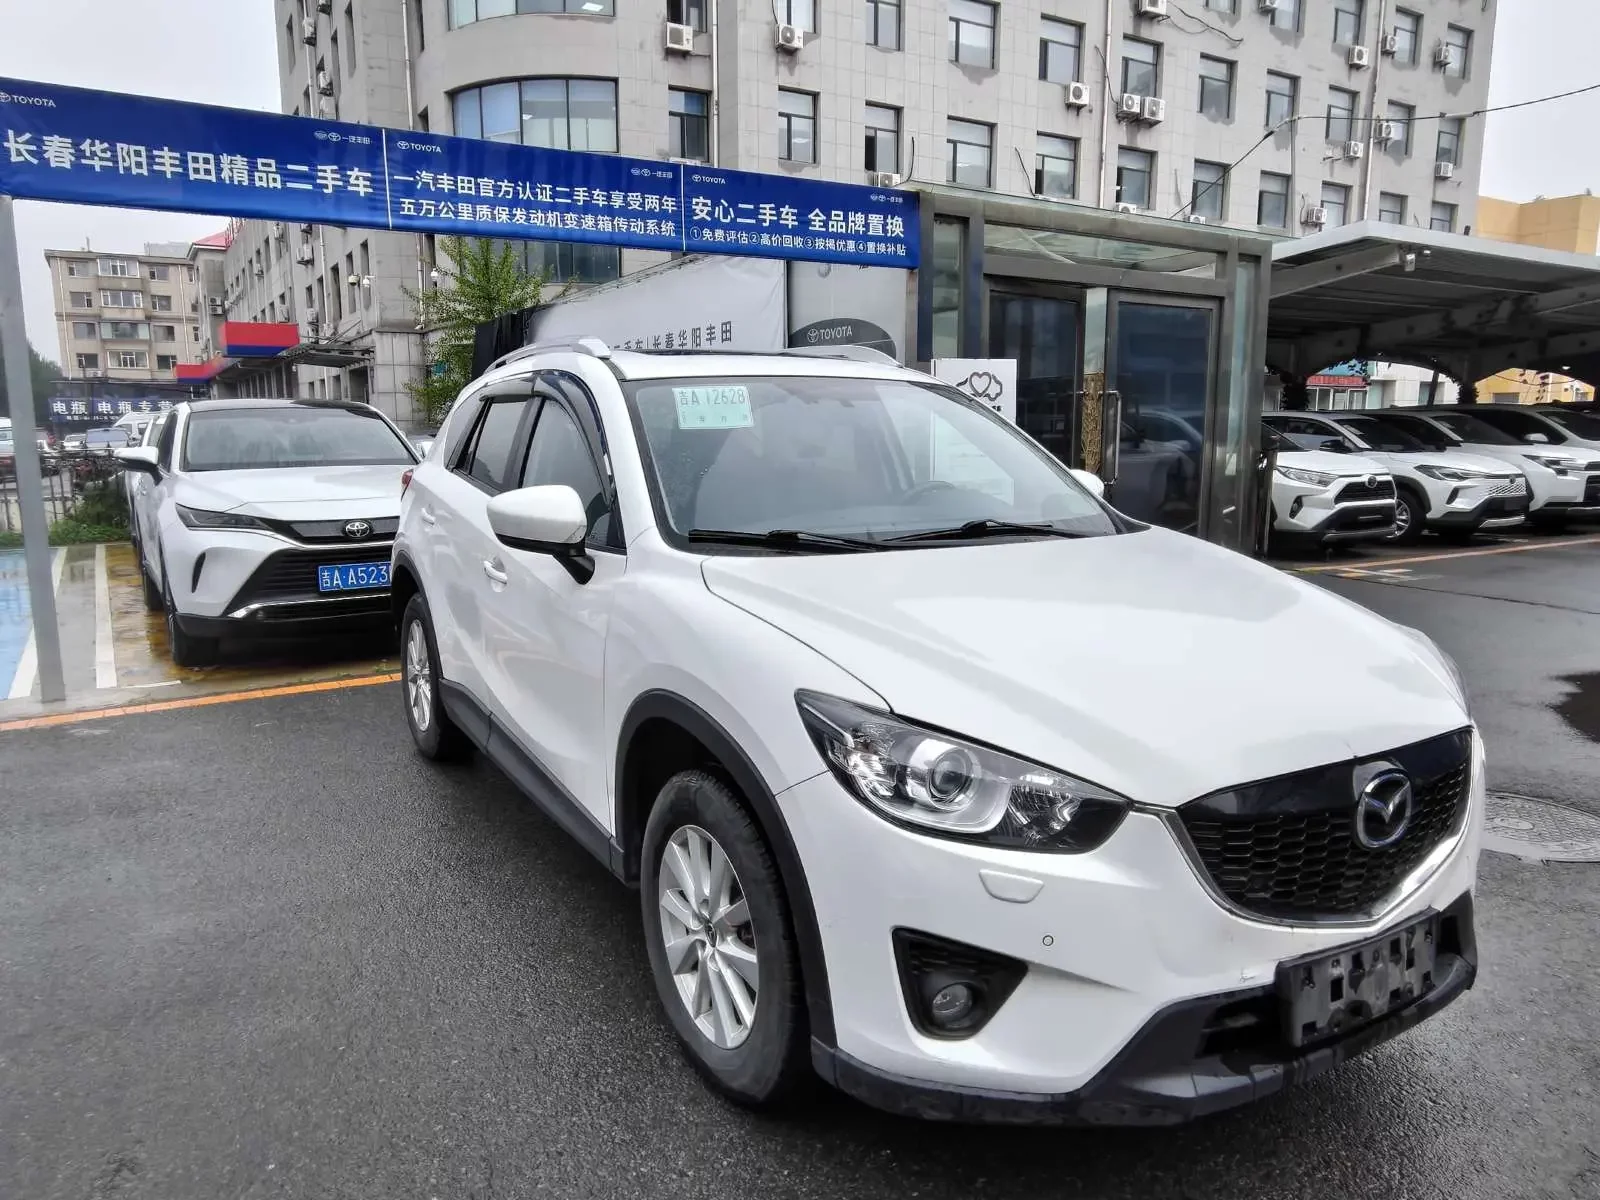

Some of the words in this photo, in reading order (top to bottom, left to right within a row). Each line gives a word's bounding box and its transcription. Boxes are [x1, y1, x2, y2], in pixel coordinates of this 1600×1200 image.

[12, 95, 56, 108] TOYOTA
[411, 143, 441, 153] TOYOTA
[3, 129, 374, 197] 长春华阳丰田精品二手车
[394, 170, 677, 213] 一汽丰田官方认证二手车享受两年
[702, 176, 725, 185] TOYOTA
[400, 198, 676, 237] 五万公里质保发动机变速箱传动系统
[692, 197, 799, 229] 安心二手车
[808, 208, 905, 238] 全品牌置换
[820, 325, 853, 340] TOYOTA
